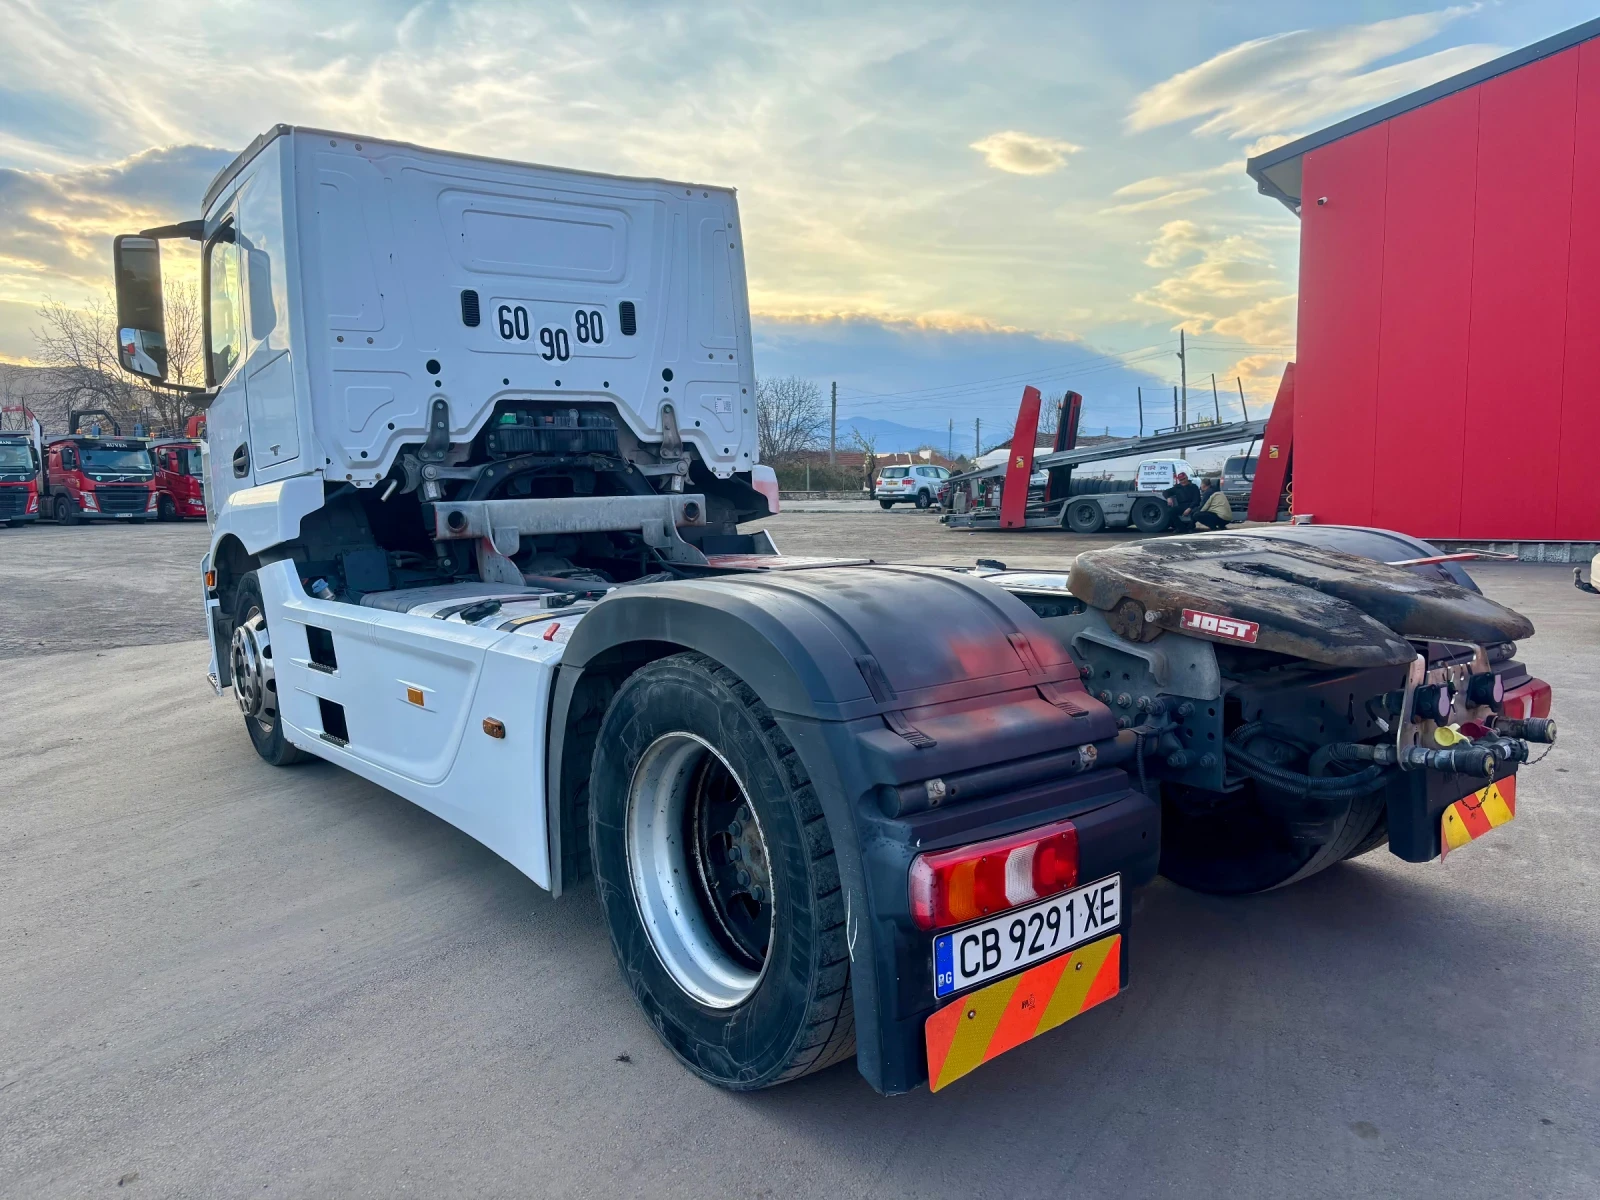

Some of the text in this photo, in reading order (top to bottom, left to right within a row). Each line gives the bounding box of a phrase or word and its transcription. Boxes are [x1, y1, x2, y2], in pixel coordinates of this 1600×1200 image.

[498, 304, 530, 341] 60
[575, 309, 604, 344] 80
[539, 327, 570, 362] 90
[1187, 613, 1251, 638] JOST
[960, 885, 1116, 978] CB 9291 XE
